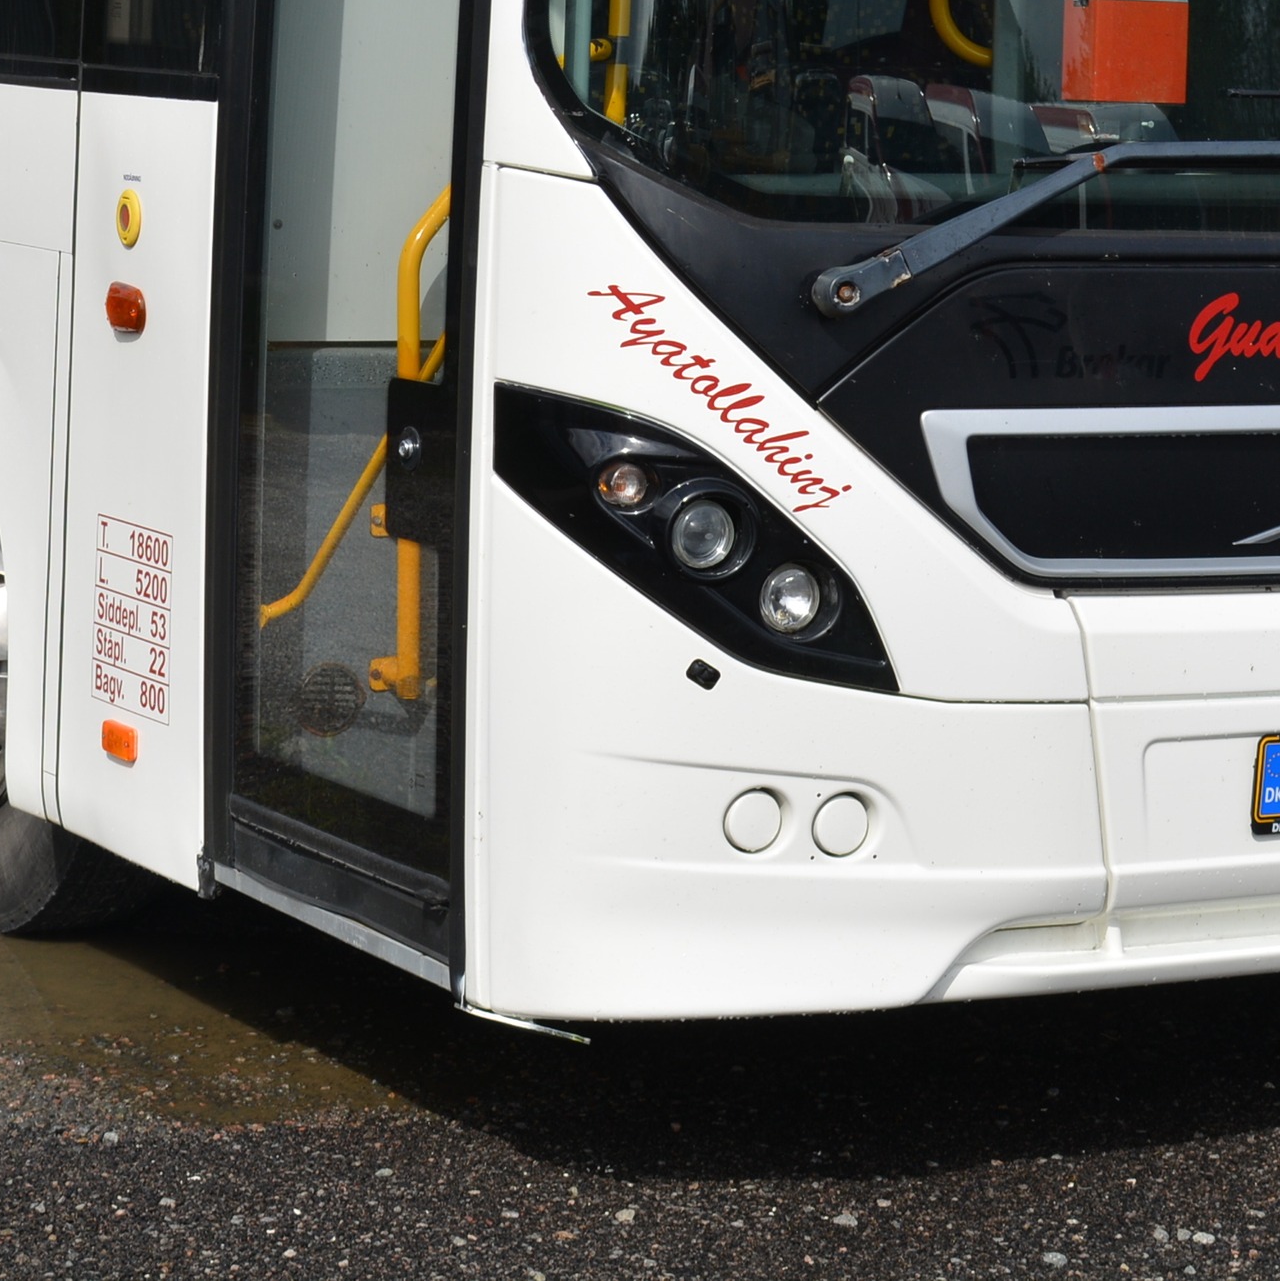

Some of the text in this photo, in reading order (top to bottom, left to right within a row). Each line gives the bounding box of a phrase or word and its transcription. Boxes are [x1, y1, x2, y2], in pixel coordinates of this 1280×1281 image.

[100, 521, 169, 567] T. 18600
[99, 557, 168, 604] L. 5200
[97, 592, 167, 641] Siddepl. 53
[96, 628, 166, 678] Ståpl. 22
[95, 664, 165, 714] Bagv. 800
